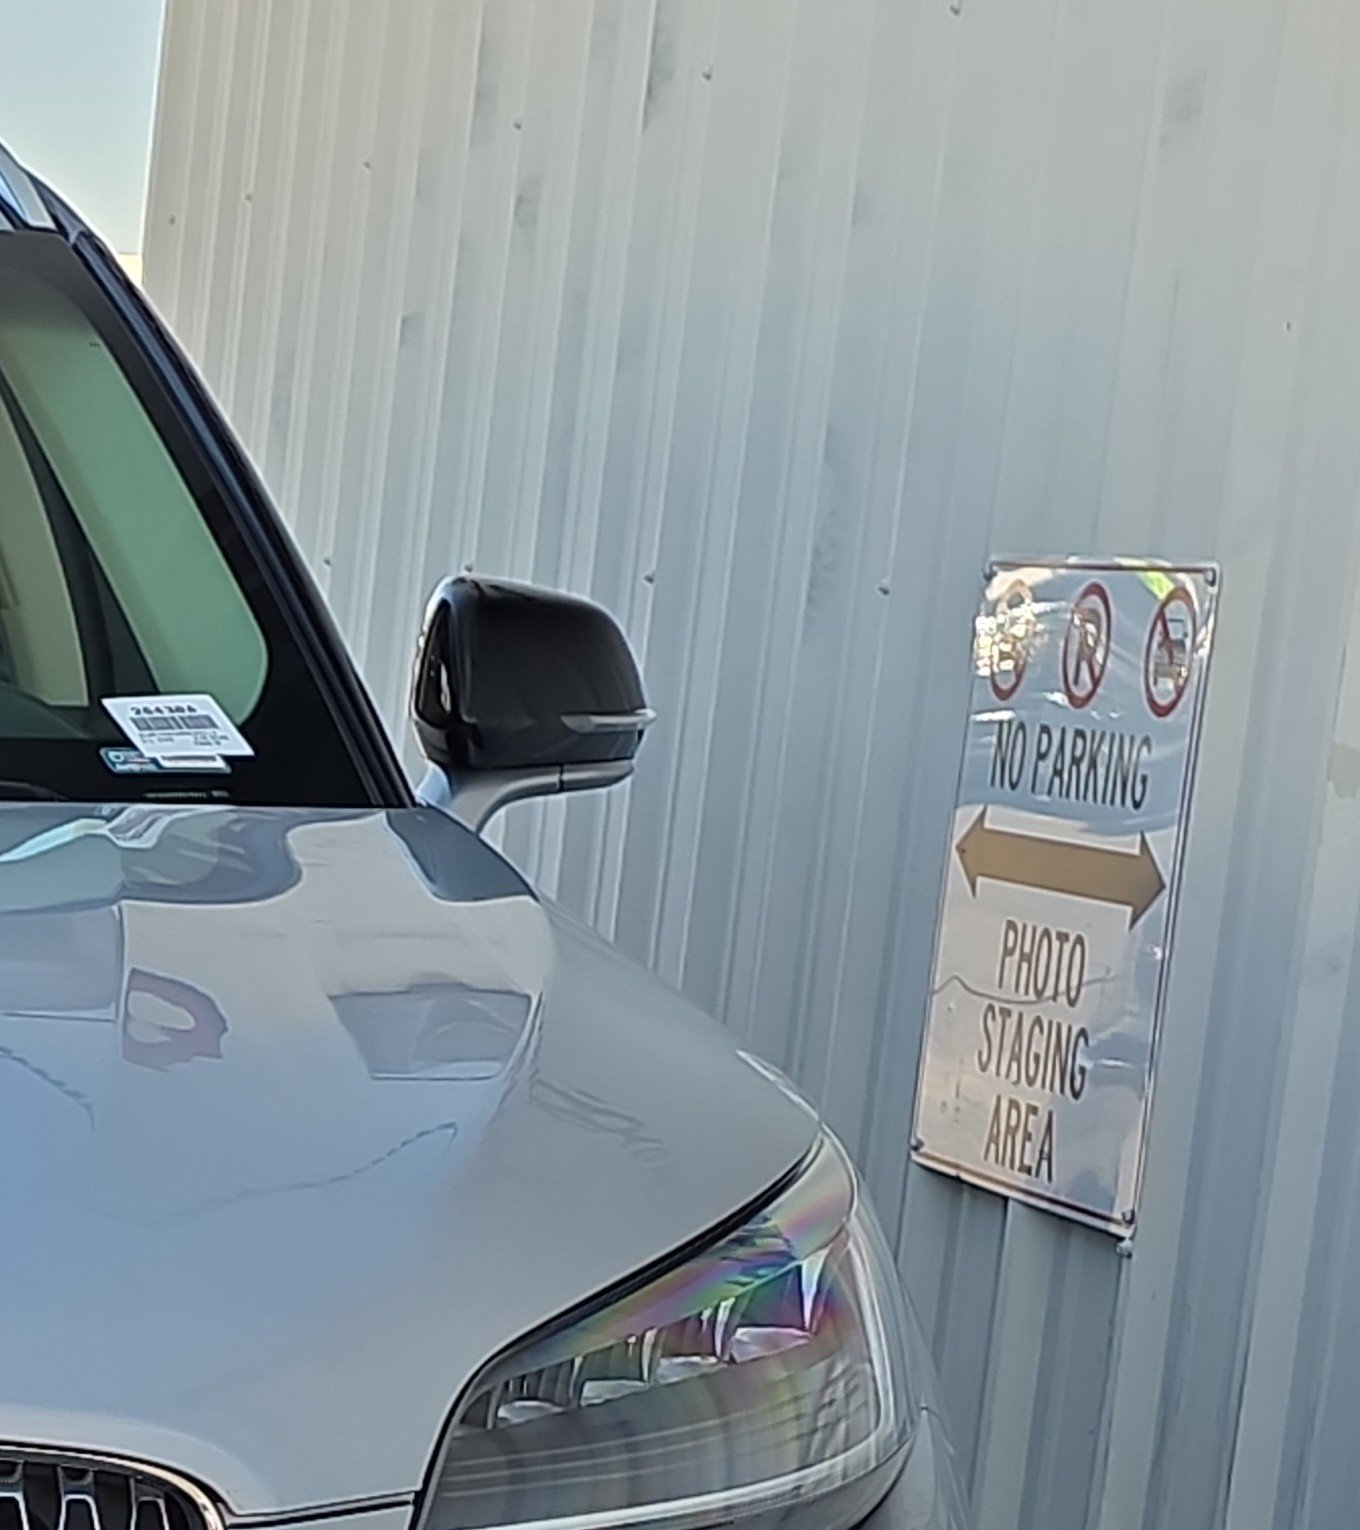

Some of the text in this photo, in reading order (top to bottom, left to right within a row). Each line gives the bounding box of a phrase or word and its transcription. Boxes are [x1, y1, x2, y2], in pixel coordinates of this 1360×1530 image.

[990, 720, 1152, 811] NO PARKING
[998, 919, 1086, 1008] PHOTO
[977, 1003, 1089, 1100] STAGING
[983, 1094, 1055, 1184] AREA
